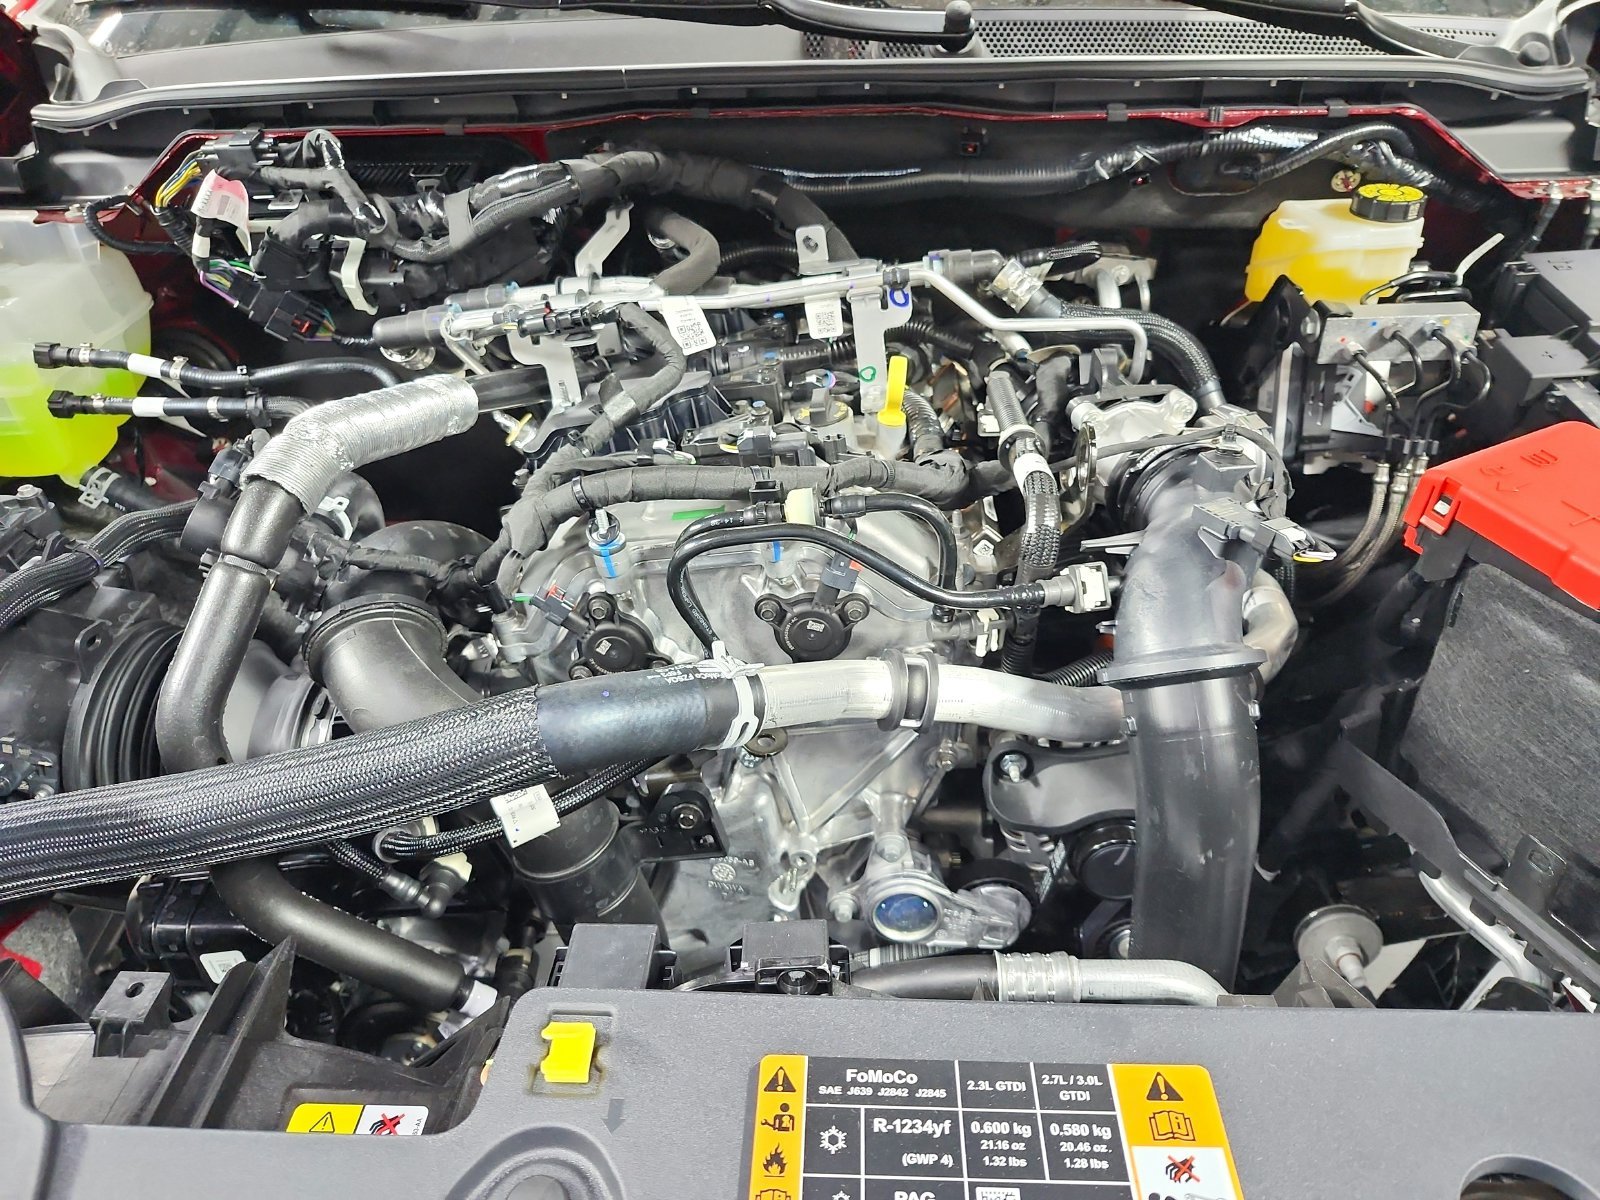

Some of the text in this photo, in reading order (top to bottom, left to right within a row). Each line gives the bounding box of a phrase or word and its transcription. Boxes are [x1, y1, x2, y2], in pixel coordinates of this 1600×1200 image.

[846, 1069, 918, 1084] FoMoCo
[1042, 1074, 1069, 1085] 2.7L
[1076, 1075, 1103, 1086] 3.0L
[819, 1085, 947, 1098] SAE J639 J2842 J2845
[967, 1080, 1026, 1092] 2.3L GTDI
[1059, 1090, 1091, 1101] GTDI
[873, 1117, 951, 1138] R-1234yf
[970, 1121, 1032, 1138] 0.600 kg
[1050, 1123, 1112, 1139] 0.580 kg
[980, 1140, 1026, 1150] 21.16 oz
[1059, 1142, 1091, 1152] 20.46
[902, 1153, 954, 1168] (GWP 4)
[983, 1156, 1027, 1167] 1.32 lbs
[1064, 1158, 1109, 1169] 1.28 lbs
